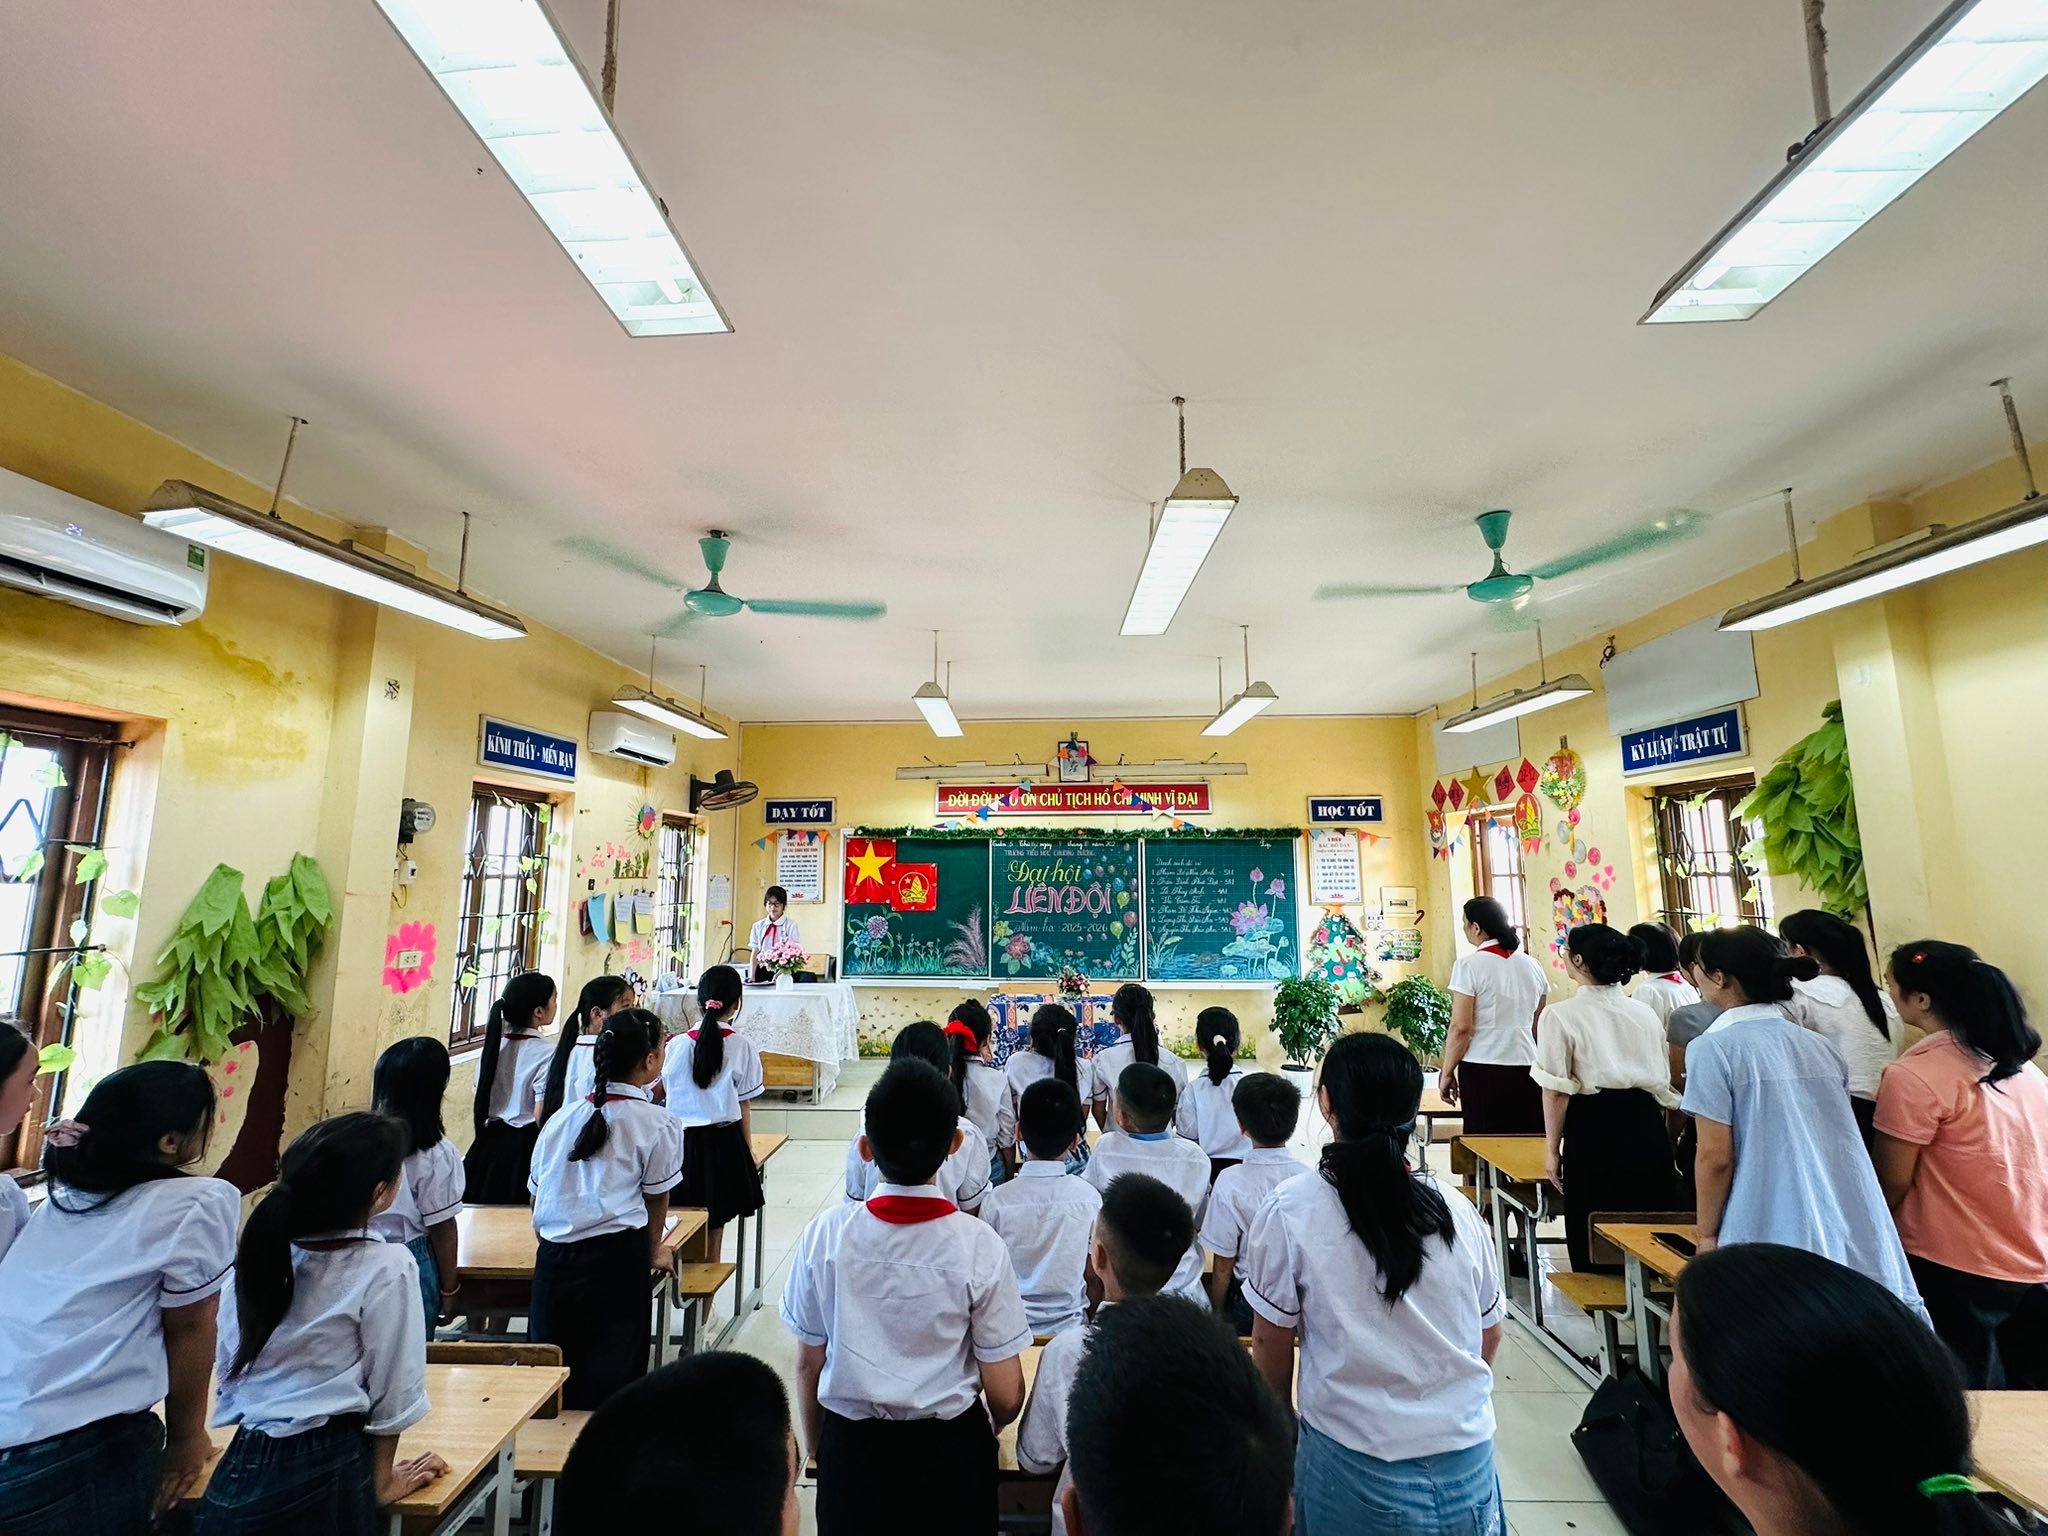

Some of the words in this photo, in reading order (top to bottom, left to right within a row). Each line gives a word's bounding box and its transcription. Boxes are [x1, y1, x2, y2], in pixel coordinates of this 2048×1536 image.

[487, 731, 512, 756] KÍNH
[541, 743, 558, 765] MẾN
[558, 750, 574, 771] BẠN
[1648, 735, 1673, 760] LUẬT
[1680, 727, 1710, 753] TRẬT
[1711, 722, 1728, 748] TỰ
[772, 807, 798, 820] DẠY
[801, 803, 826, 818] TỐT
[1021, 791, 1037, 806] ƠN
[1040, 788, 1062, 806] CHỦ
[1065, 792, 1091, 809] TỊCH
[1094, 787, 1110, 805] HỒ
[1164, 790, 1175, 805] VĨ
[1177, 792, 1198, 808] ĐẠI
[1318, 805, 1345, 819] HỌC
[1348, 801, 1374, 817] TỐT
[1004, 859, 1050, 887] Đại
[1050, 858, 1082, 886] hội
[1003, 882, 1067, 914] LIÊN
[1063, 881, 1112, 918] ĐỘI
